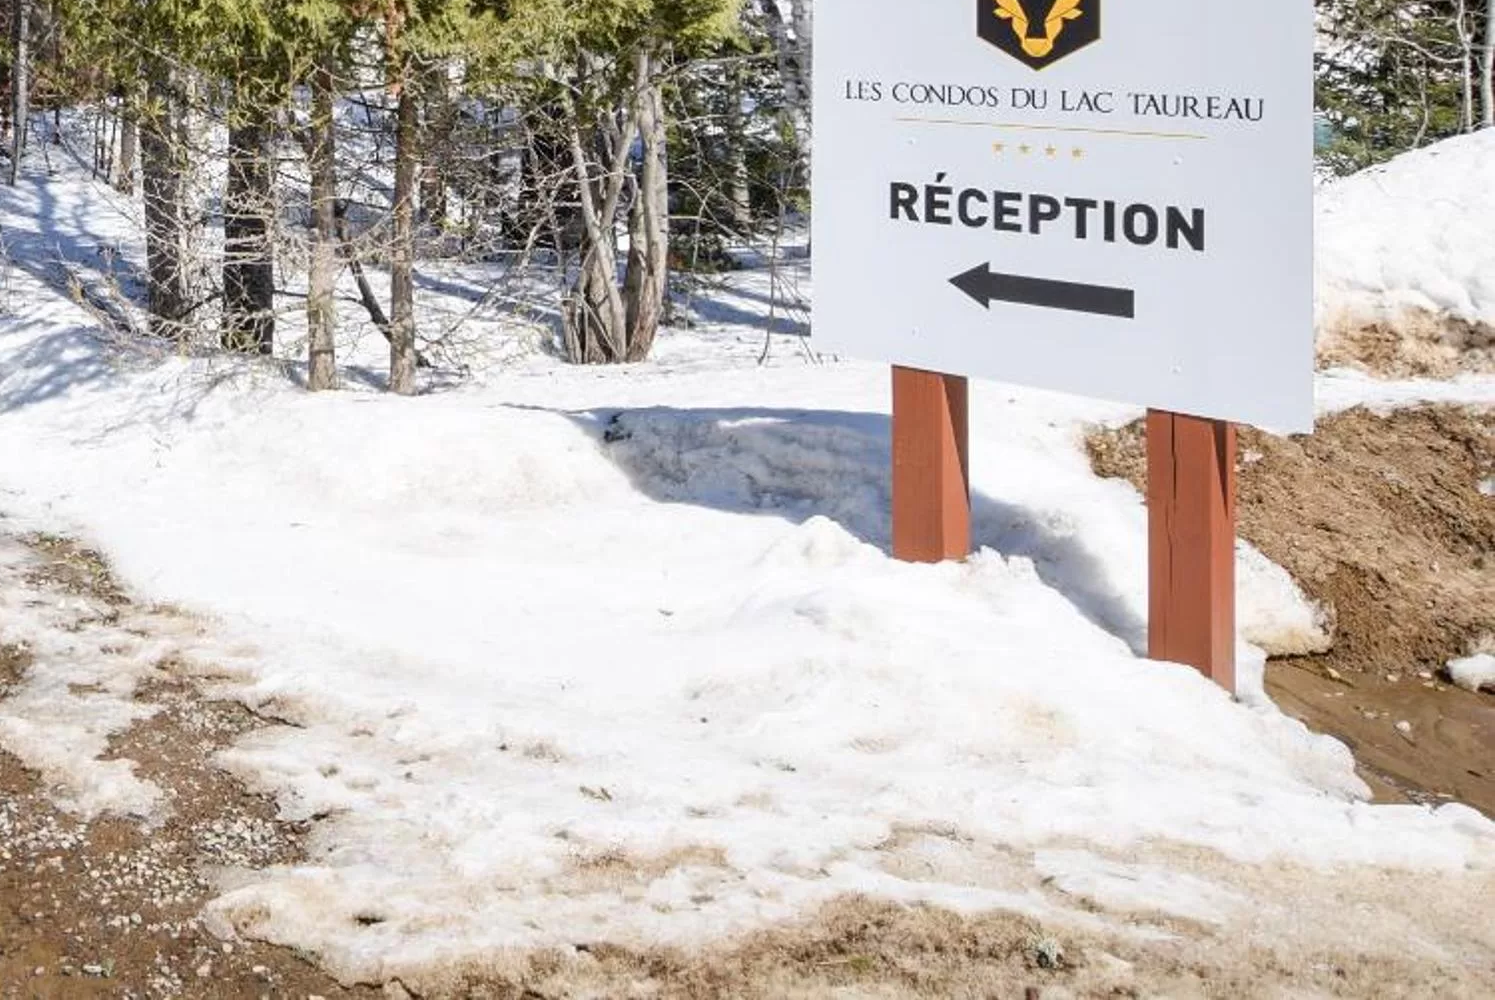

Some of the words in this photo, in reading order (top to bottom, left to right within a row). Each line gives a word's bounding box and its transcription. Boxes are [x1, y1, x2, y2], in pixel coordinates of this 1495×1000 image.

[845, 80, 882, 102] LES
[892, 83, 999, 108] CONDOS
[1011, 88, 1047, 110] DU
[1060, 90, 1113, 114] LAC
[1127, 92, 1265, 122] TAUREAU
[889, 172, 1205, 252] RÉCEPTION
